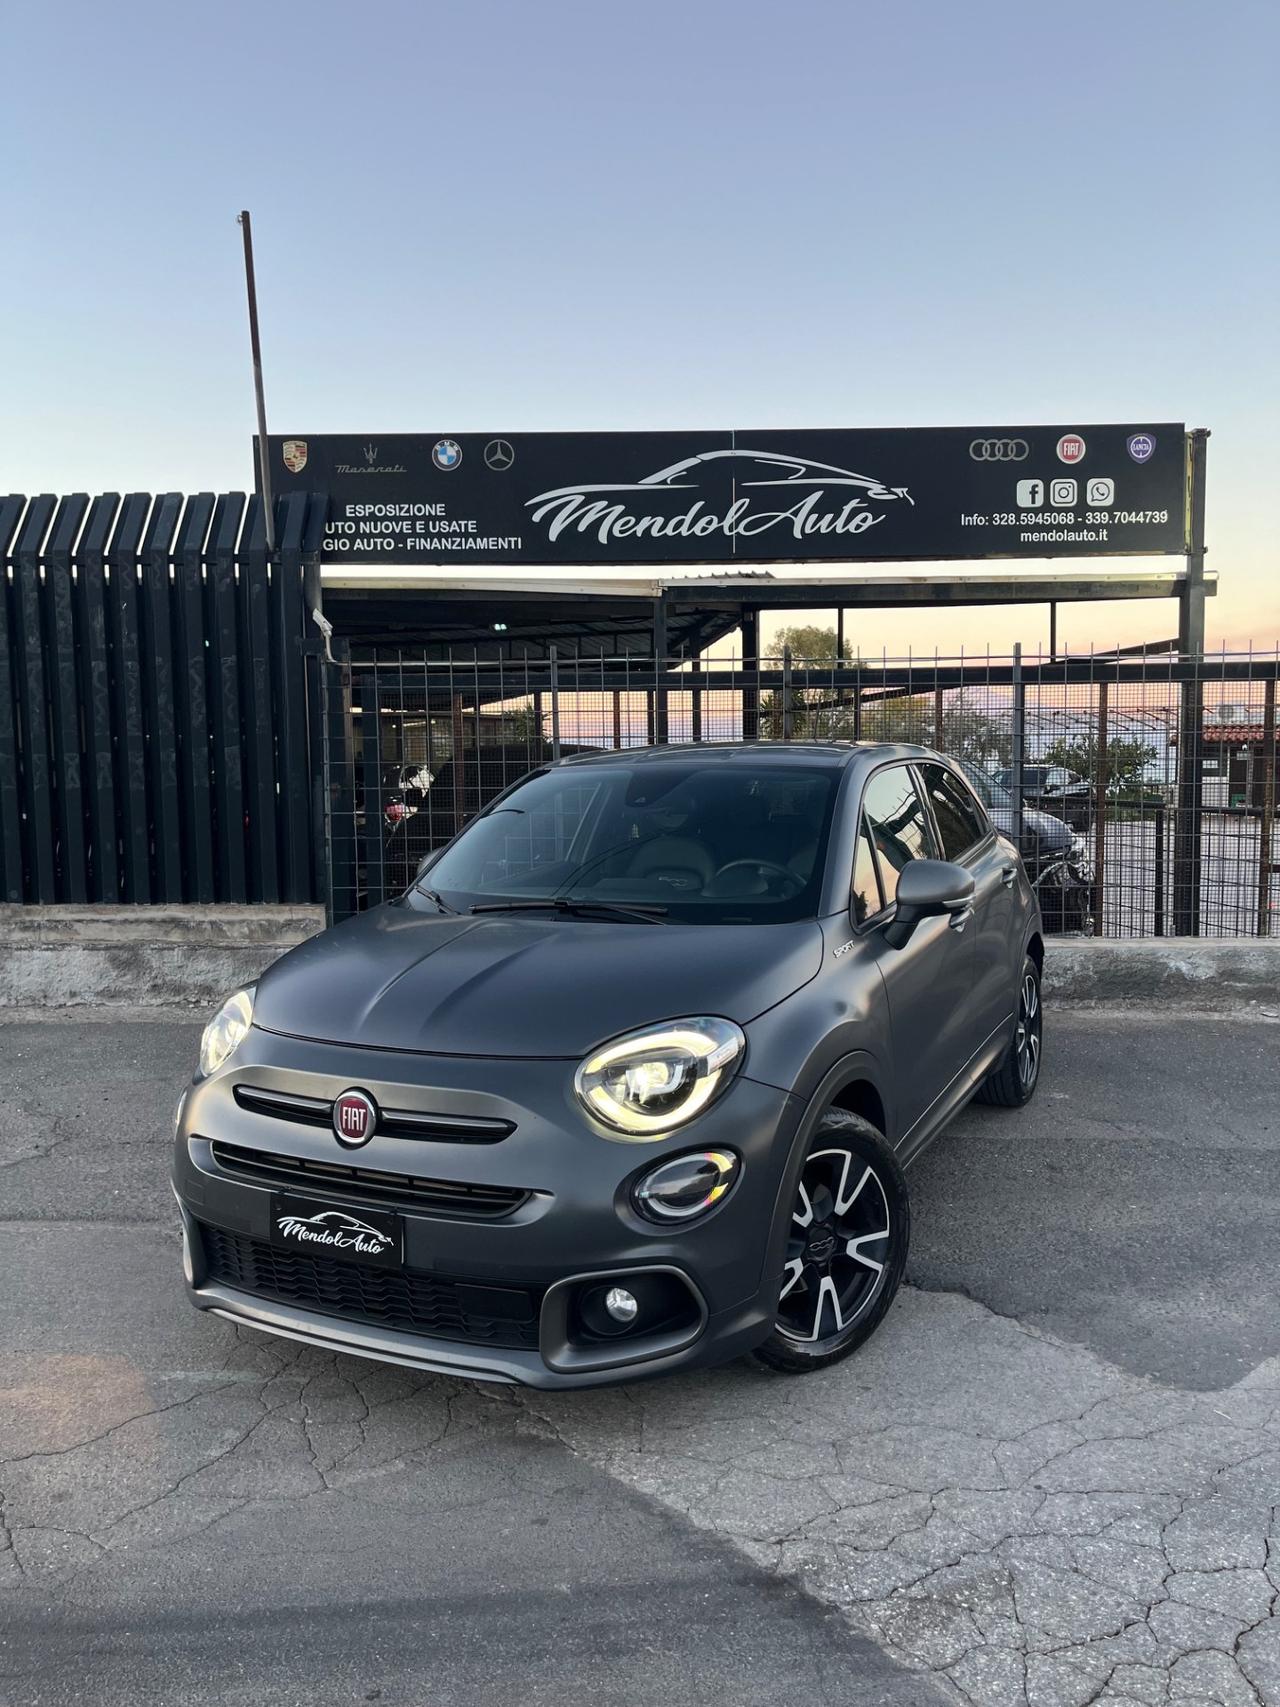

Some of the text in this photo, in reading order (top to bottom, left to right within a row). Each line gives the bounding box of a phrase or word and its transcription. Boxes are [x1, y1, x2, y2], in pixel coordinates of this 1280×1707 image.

[1063, 442, 1079, 456] FIAT
[335, 465, 407, 473] Maserati
[345, 503, 446, 517] ESPOSIZIONE
[961, 513, 989, 526] Info:
[992, 512, 1075, 526] 328.5945068
[1085, 510, 1168, 525] 339.7044739
[325, 521, 478, 534] UTO NUOVE E USATE
[1020, 528, 1108, 542] mendolauto.it
[353, 538, 395, 551] AUTO
[406, 537, 522, 551] FINANZIAMENTI
[833, 940, 855, 958] SPORT
[342, 1106, 367, 1132] FIAT
